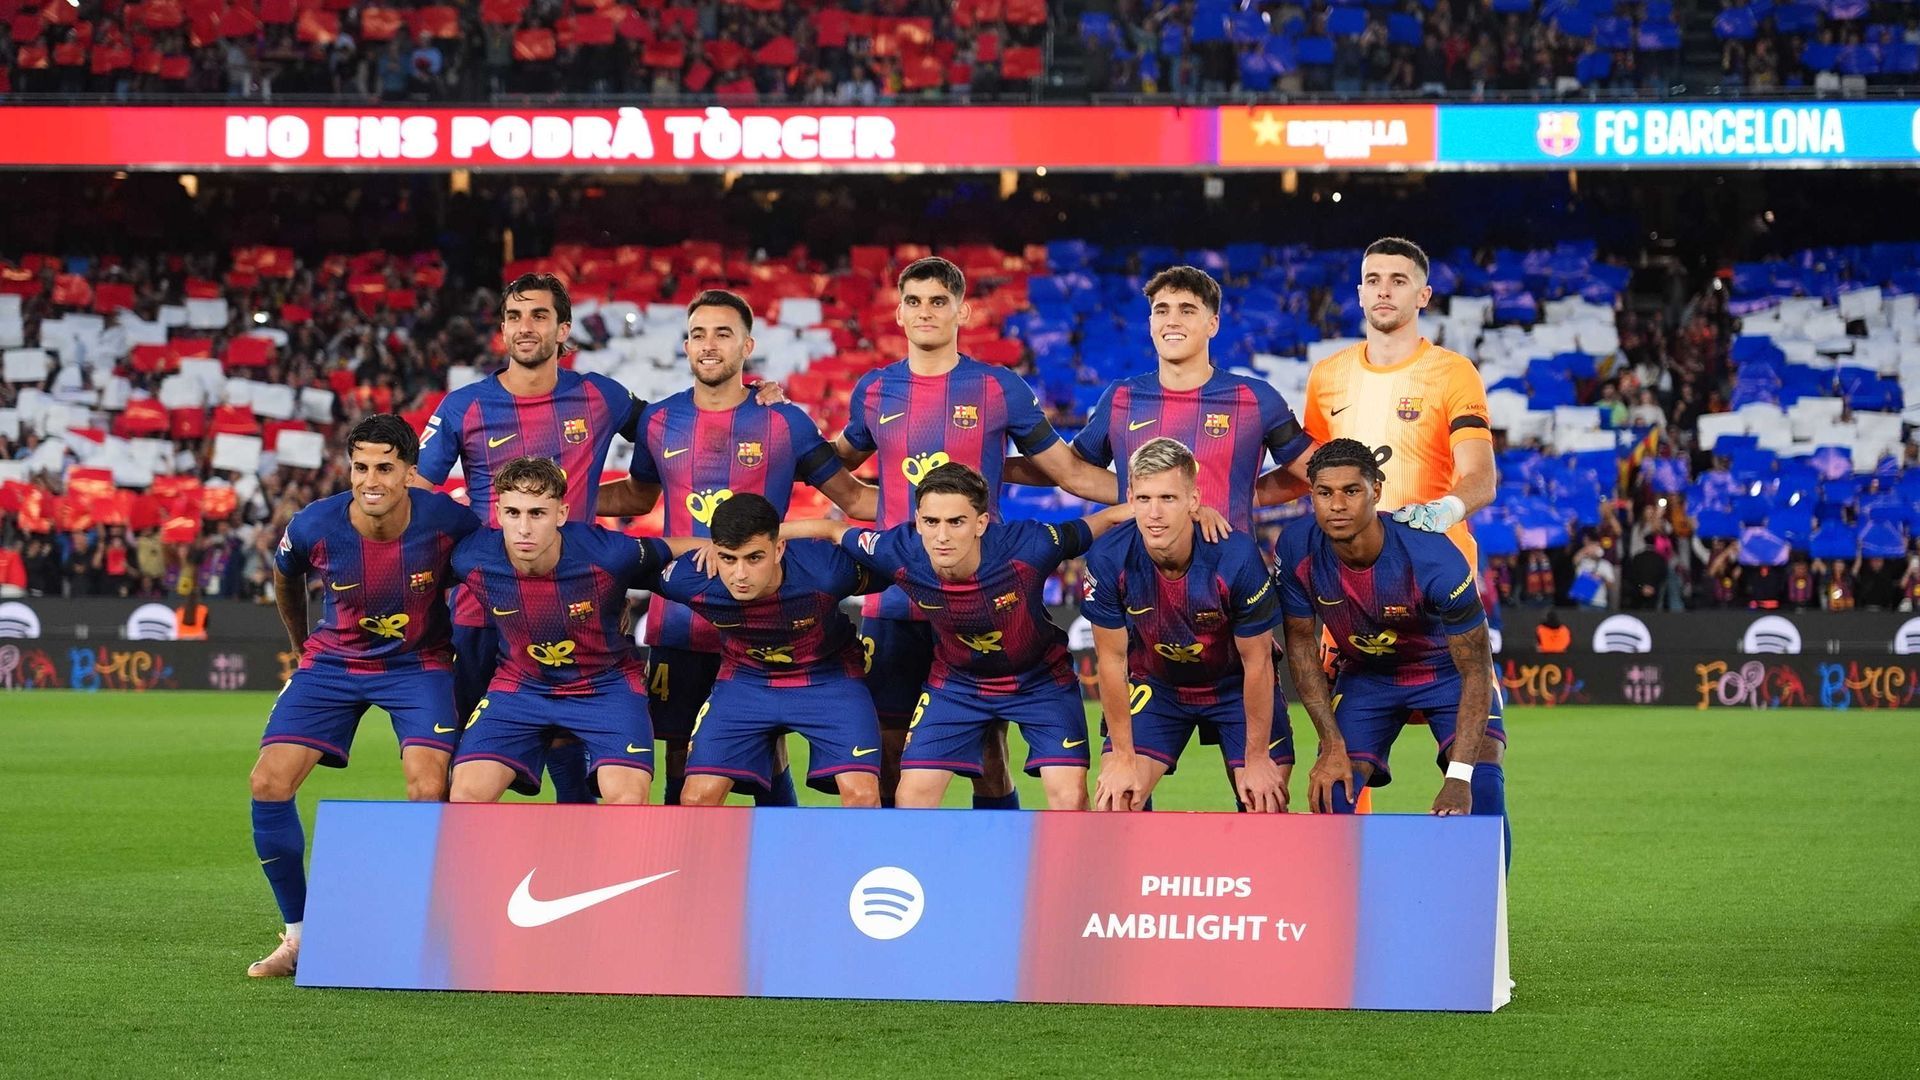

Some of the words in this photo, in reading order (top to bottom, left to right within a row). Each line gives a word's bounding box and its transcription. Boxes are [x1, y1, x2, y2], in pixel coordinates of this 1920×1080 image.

[225, 116, 310, 158] NO
[323, 116, 438, 158] ENS
[451, 107, 654, 158] PODRÀ
[664, 107, 896, 159] TÒRCER
[1595, 109, 1638, 155] FC
[1644, 108, 1846, 154] BARCELONA
[1141, 875, 1252, 898] PHILIPS
[1081, 912, 1268, 941] AMBILIGHT
[1275, 917, 1307, 942] tv
